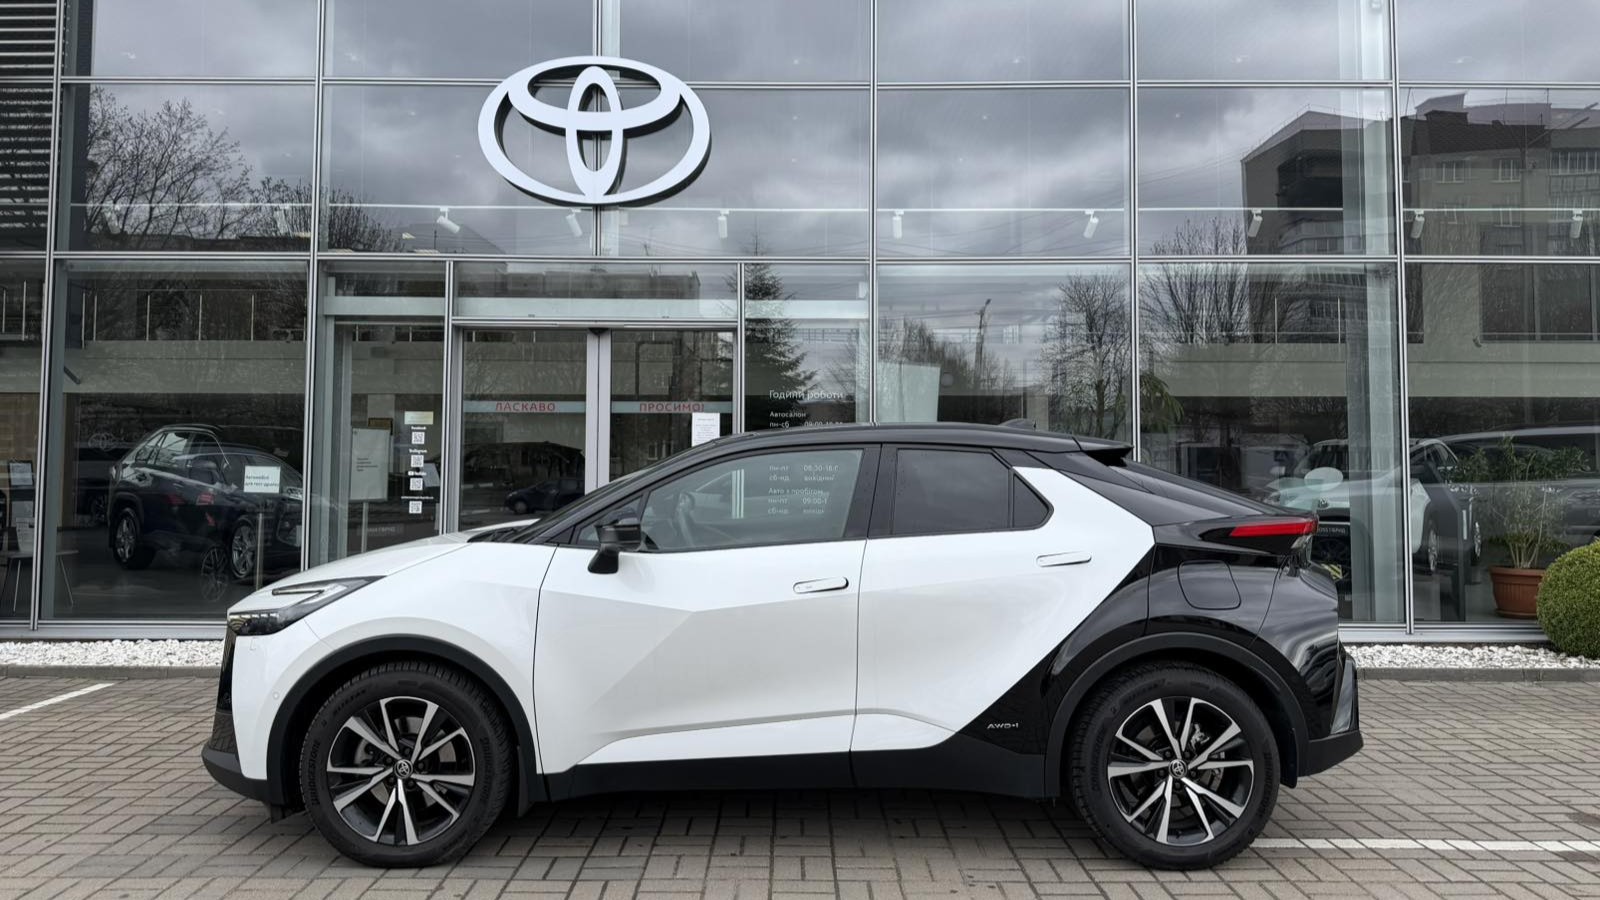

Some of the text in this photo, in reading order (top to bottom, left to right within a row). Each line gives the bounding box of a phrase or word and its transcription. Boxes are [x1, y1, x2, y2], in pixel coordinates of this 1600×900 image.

[769, 389, 844, 401] Години роботи
[495, 402, 705, 413] ЛАСКАВО ПРОСИМО!
[769, 420, 790, 429] пн-сб
